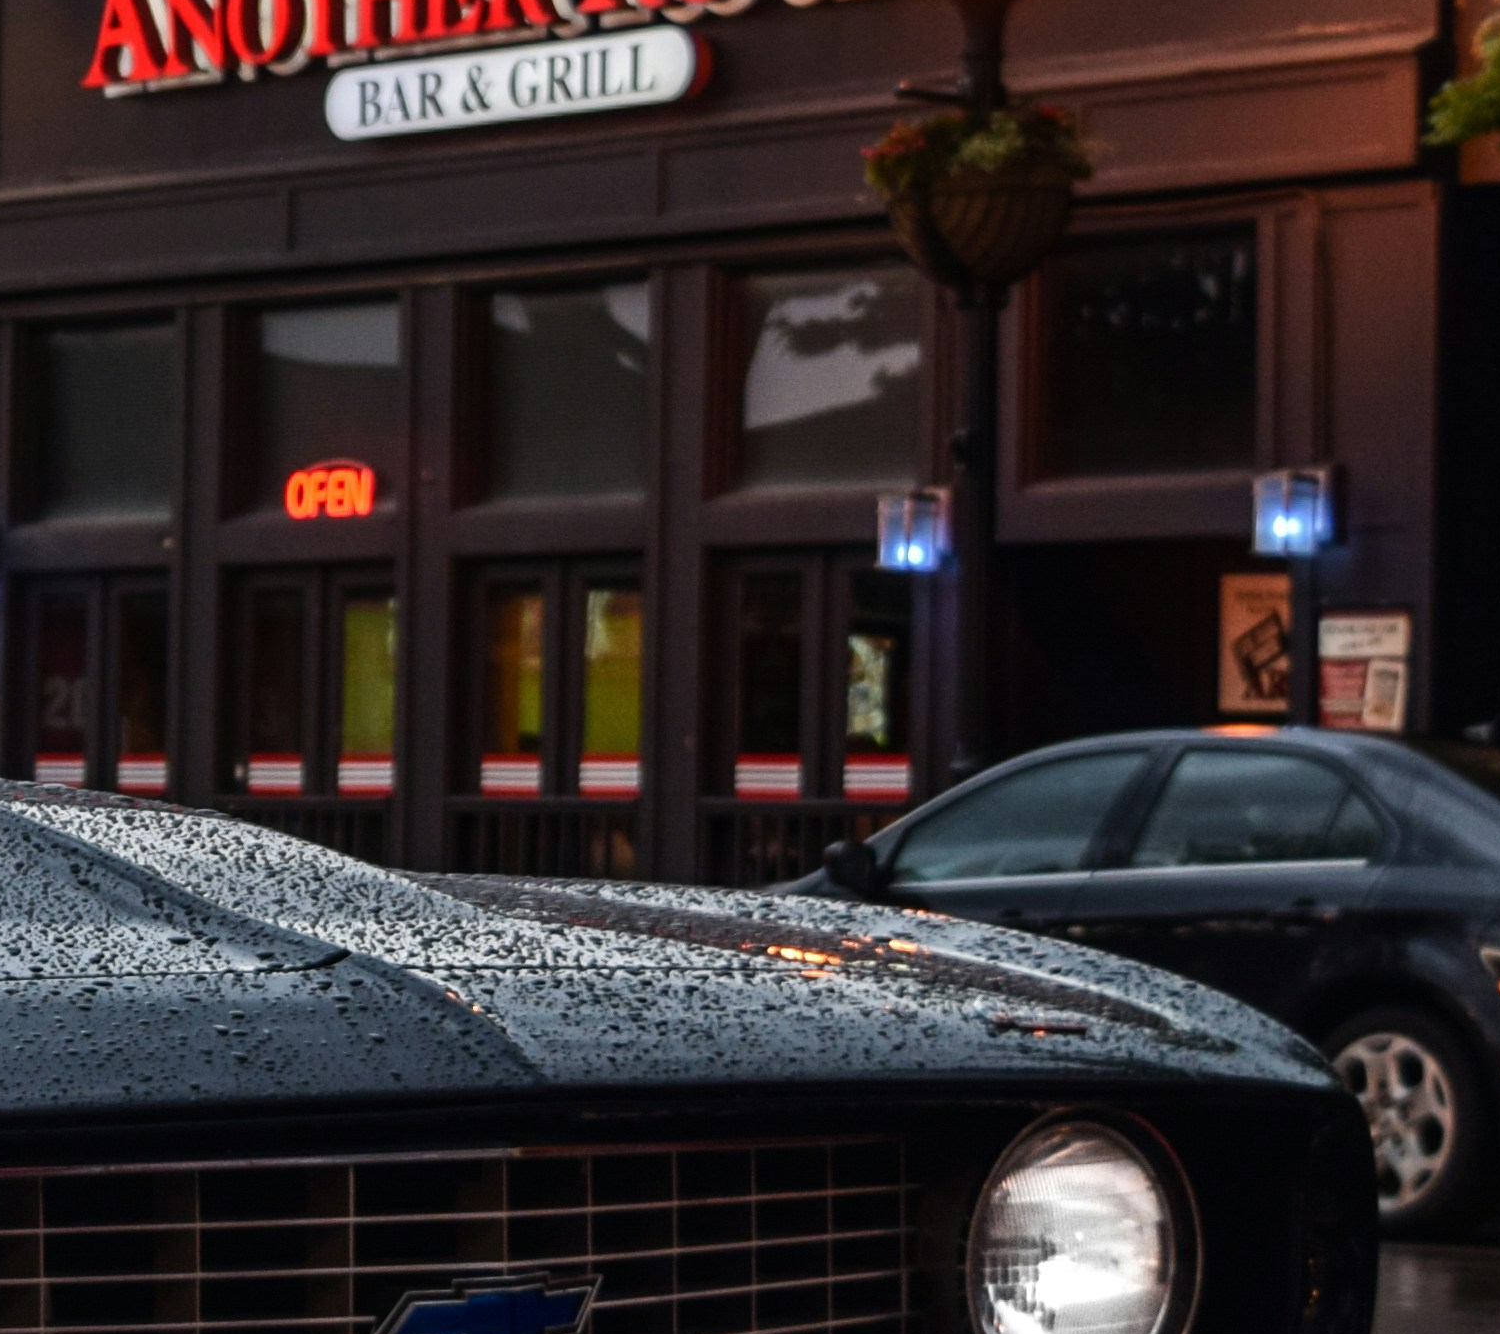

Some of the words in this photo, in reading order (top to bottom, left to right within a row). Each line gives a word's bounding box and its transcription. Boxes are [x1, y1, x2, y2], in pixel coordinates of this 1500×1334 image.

[356, 70, 444, 129] BAR
[459, 64, 494, 116] &
[507, 43, 659, 110] GRILL
[284, 467, 375, 520] OPEN
